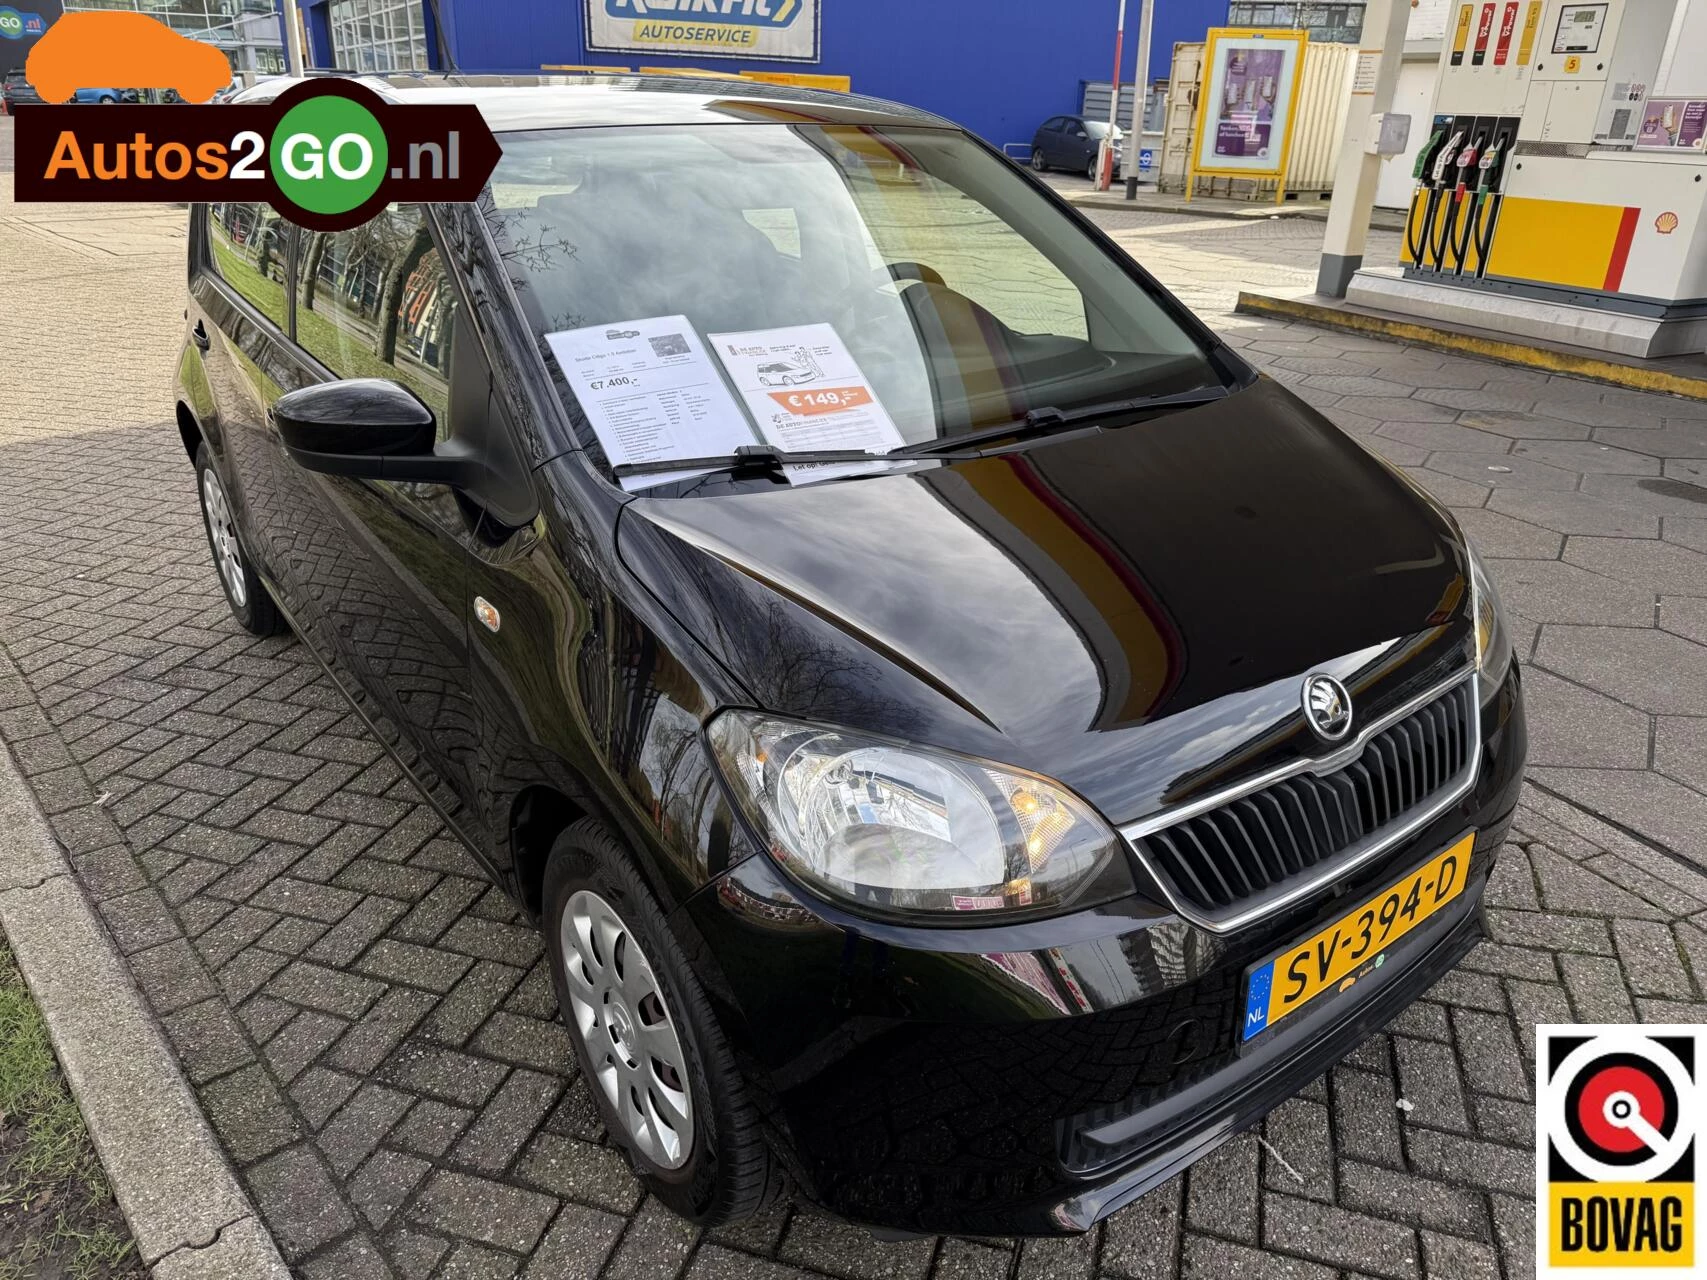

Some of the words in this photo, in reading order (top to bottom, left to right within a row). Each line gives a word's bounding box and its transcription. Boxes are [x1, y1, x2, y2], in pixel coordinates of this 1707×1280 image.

[640, 25, 751, 43] AUTOSERVICE
[1568, 59, 1576, 70] 5
[788, 395, 802, 407] €
[1283, 855, 1457, 1004] SV-394-D
[1247, 1007, 1265, 1028] NL
